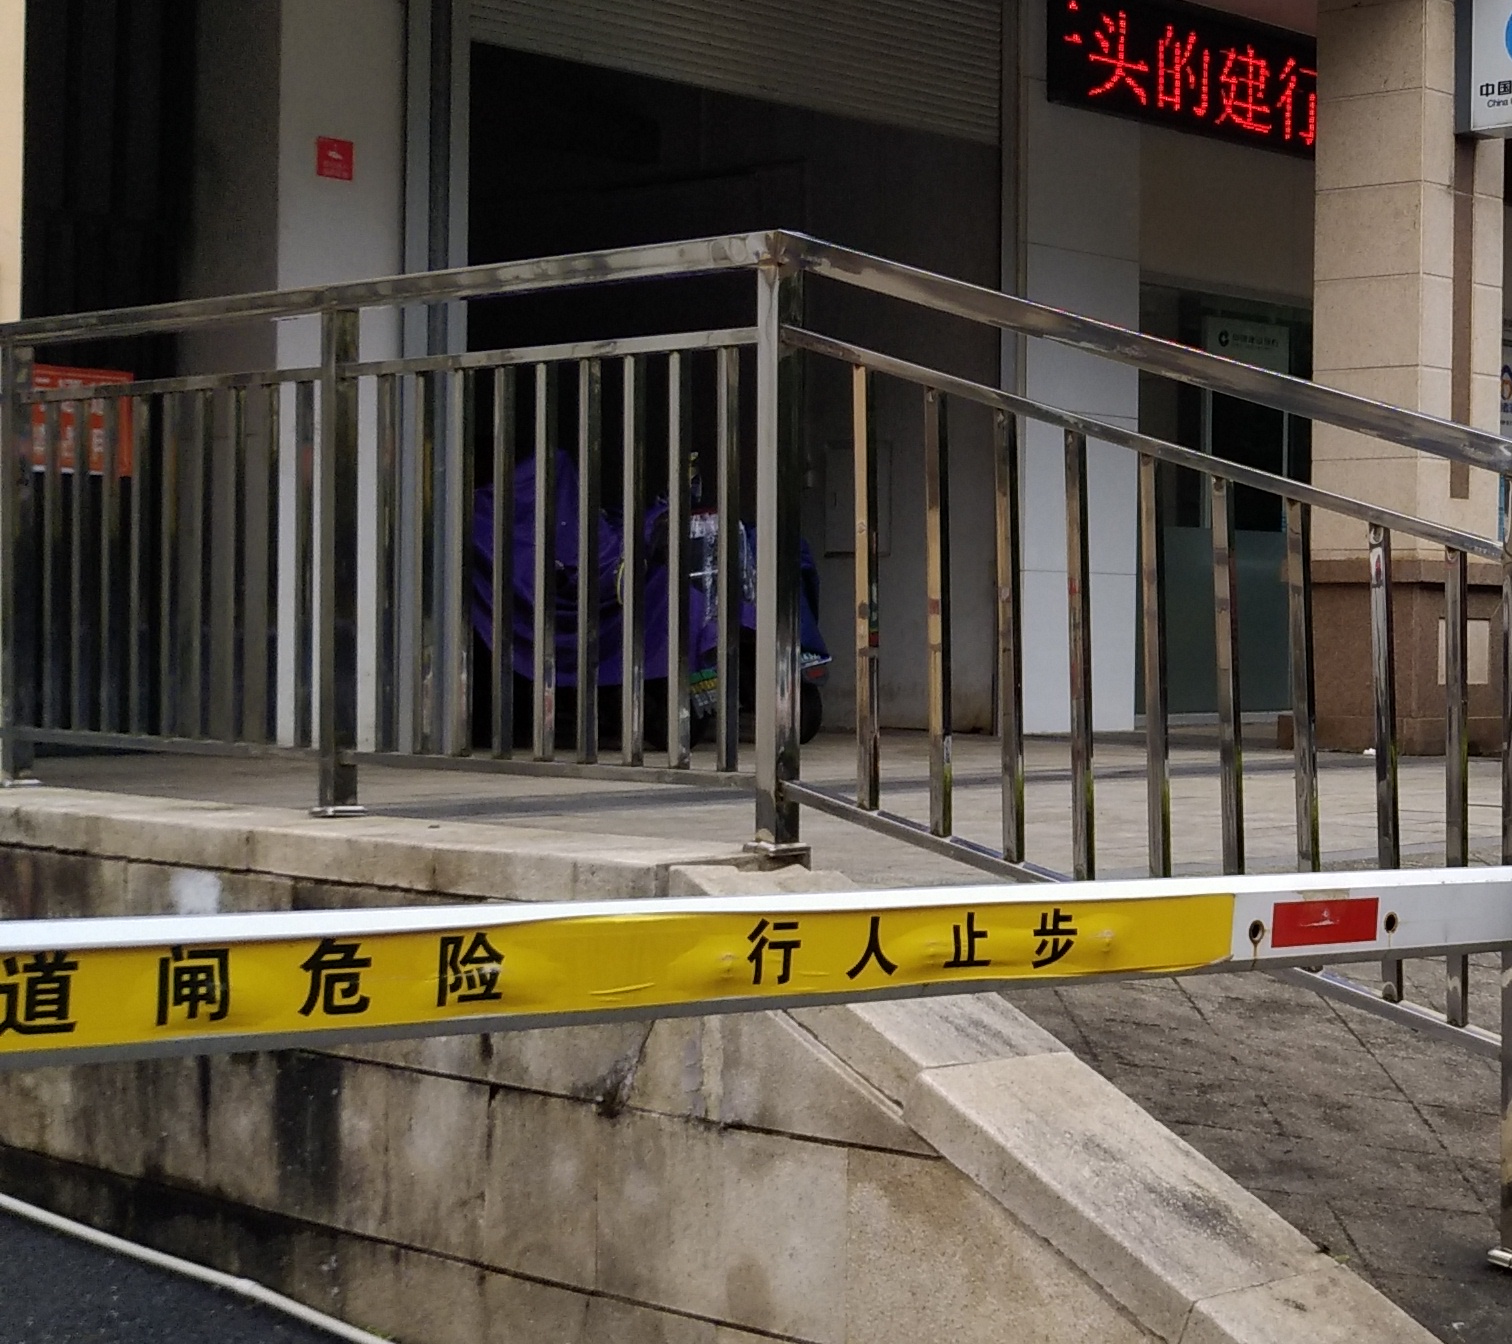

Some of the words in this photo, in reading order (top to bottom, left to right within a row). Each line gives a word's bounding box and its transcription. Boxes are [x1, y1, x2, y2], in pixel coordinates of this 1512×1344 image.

[1064, 0, 1317, 145] 头的建行
[1487, 99, 1508, 108] China
[0, 935, 504, 1034] 道闸危险
[746, 909, 1079, 986] 行人止步
